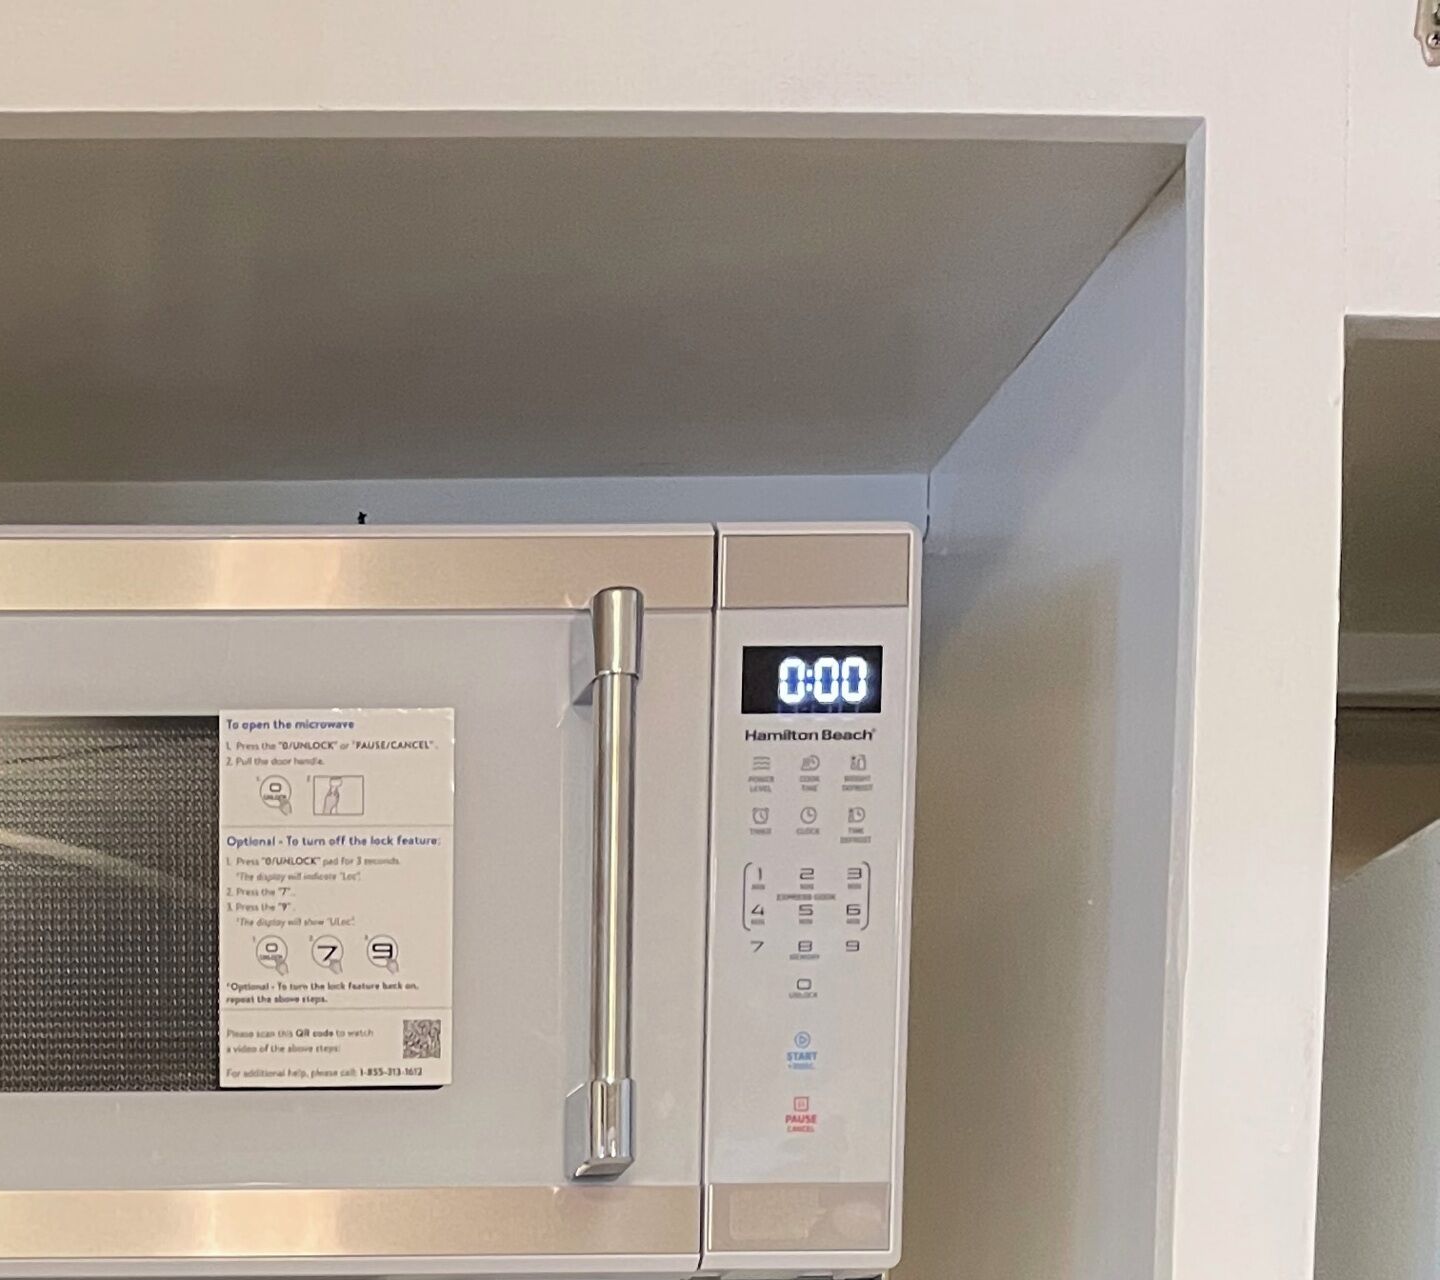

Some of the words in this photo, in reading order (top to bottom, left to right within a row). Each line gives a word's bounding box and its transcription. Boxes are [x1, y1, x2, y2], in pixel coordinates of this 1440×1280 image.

[779, 657, 867, 704] 0:00
[226, 719, 239, 730] To
[242, 721, 270, 732] open
[273, 719, 292, 730] the
[295, 719, 354, 730] microwave
[745, 729, 818, 741] Hamilton
[236, 741, 259, 751] Press
[261, 742, 276, 751] the
[236, 757, 252, 766] Pull
[254, 757, 269, 766] the
[271, 757, 291, 766] door
[227, 835, 275, 849] Optional
[286, 834, 299, 846] To
[302, 836, 325, 846] turn
[329, 834, 345, 846] off
[349, 835, 367, 846] the
[370, 835, 393, 846] lock
[236, 856, 259, 866] Press
[341, 856, 353, 866] for
[256, 872, 286, 883] display
[288, 872, 302, 881] will
[303, 872, 337, 881] indicate
[758, 867, 762, 881] 1
[800, 867, 814, 880] 2
[847, 867, 862, 880] 3
[236, 887, 259, 896] Press
[261, 887, 276, 896] the
[236, 902, 259, 912] Press
[261, 902, 276, 912] the
[751, 904, 764, 916] 4
[799, 904, 813, 916] 5
[846, 903, 861, 916] 6
[256, 916, 286, 928] display
[288, 916, 302, 926] will
[304, 916, 325, 926] show
[372, 943, 393, 959] 9
[750, 941, 764, 953] 7
[798, 940, 813, 952] 8
[845, 940, 860, 952] 9
[317, 945, 338, 961] 7
[278, 981, 287, 991] To
[290, 982, 308, 991] turn
[311, 981, 325, 990] the
[328, 981, 345, 990] lock
[348, 981, 380, 990] feature
[383, 981, 402, 990] back
[226, 996, 255, 1005] repeat
[257, 995, 271, 1004] the
[274, 995, 300, 1004] above
[226, 1029, 254, 1038] Please
[257, 1030, 275, 1038] scan
[278, 1029, 293, 1038] this
[295, 1029, 310, 1038] QR
[312, 1029, 334, 1038] code
[348, 1029, 374, 1037] watch
[234, 1044, 257, 1053] video
[260, 1044, 269, 1053] of
[270, 1044, 284, 1053] the
[288, 1044, 313, 1053] above
[786, 1051, 817, 1061] START
[226, 1068, 241, 1078] For
[243, 1068, 285, 1078] additional
[311, 1068, 338, 1079] please
[785, 1114, 817, 1124] PAUSE
